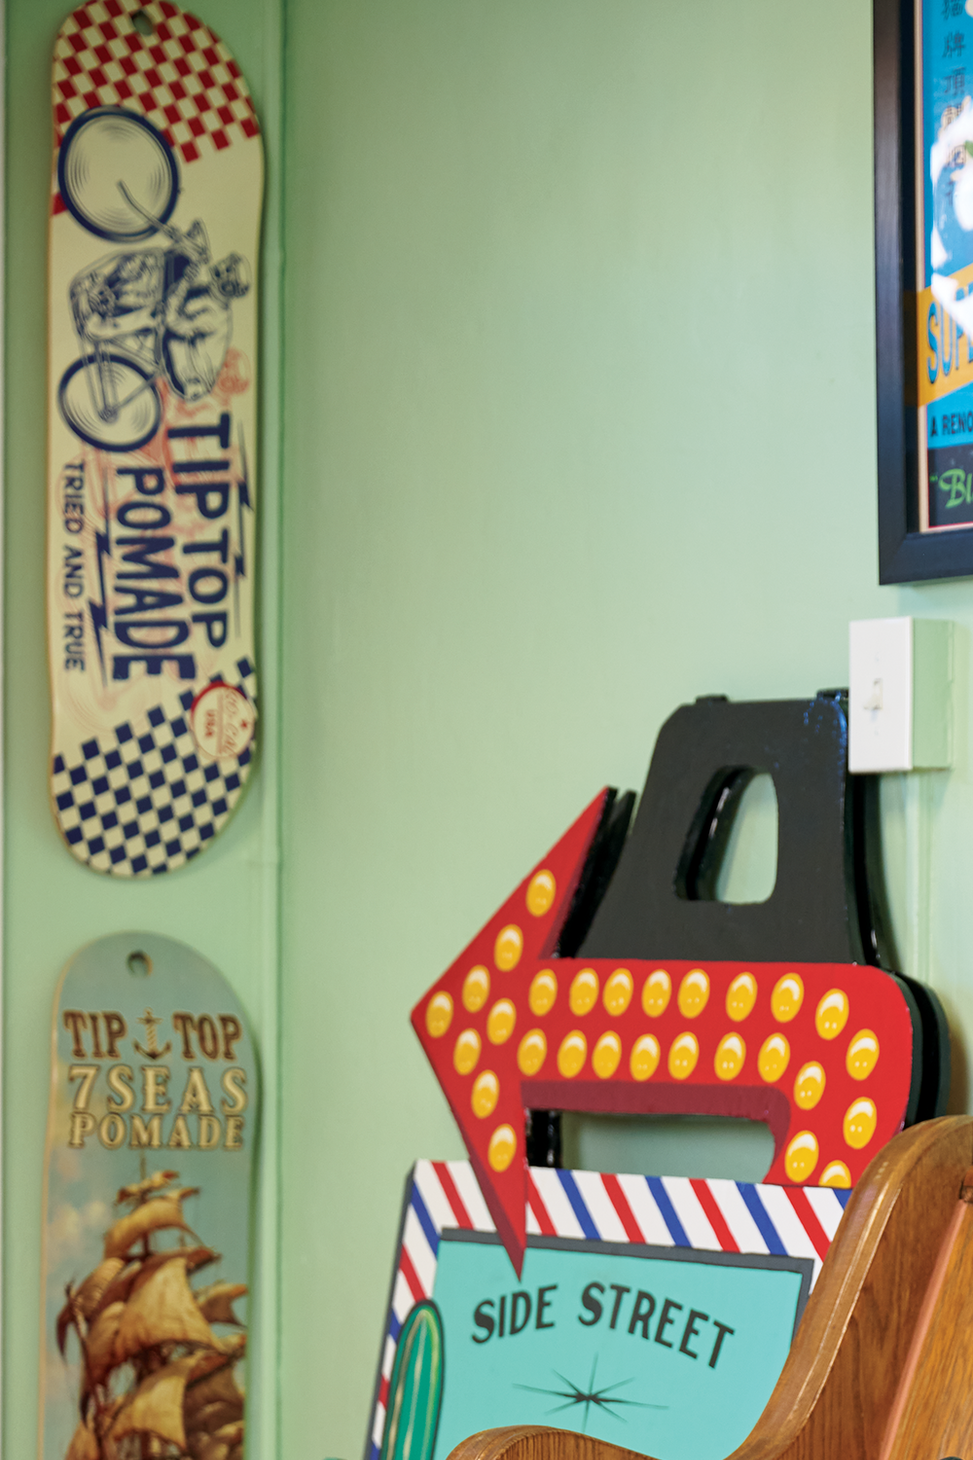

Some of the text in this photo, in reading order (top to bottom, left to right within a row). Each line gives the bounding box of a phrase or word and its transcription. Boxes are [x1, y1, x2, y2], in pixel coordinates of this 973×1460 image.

[930, 416, 938, 437] A
[63, 459, 85, 673] TRIED AND TRUE
[112, 466, 196, 681] POMADE
[63, 1009, 242, 1062] TIP TOP
[68, 1112, 244, 1150] POMADE
[471, 1281, 736, 1369] SIDE STREET
